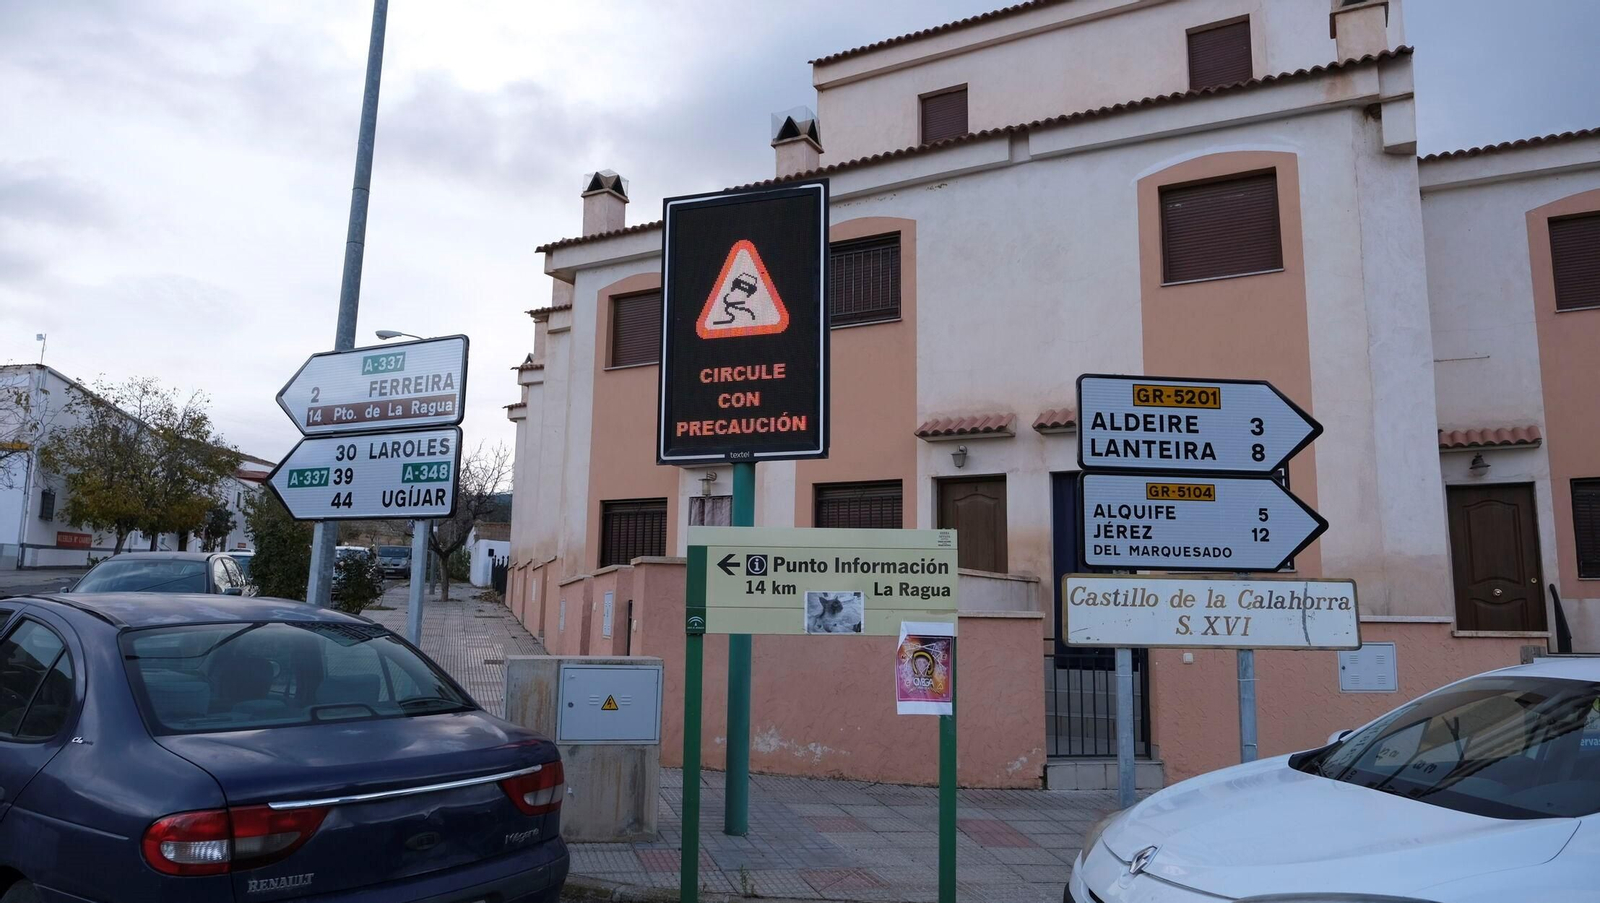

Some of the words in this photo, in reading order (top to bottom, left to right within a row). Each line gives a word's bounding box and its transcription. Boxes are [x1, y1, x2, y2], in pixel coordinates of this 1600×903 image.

[364, 355, 404, 373] A-337
[700, 363, 787, 384] CIRCULE
[310, 386, 321, 404] 2
[369, 372, 455, 398] FERREIRA
[1136, 388, 1218, 406] GR-5201
[717, 391, 761, 409] CON
[308, 409, 322, 423] 14
[333, 407, 357, 421] Pto.
[365, 404, 380, 418] de
[388, 402, 403, 416] La
[411, 400, 453, 416] Ragua
[676, 411, 808, 437] PRECAUCIÓN
[1091, 412, 1200, 434] ALDEIRE
[1250, 417, 1264, 436] 3
[335, 443, 357, 462] 30
[369, 438, 451, 460] LAROLES
[730, 451, 750, 459] textel
[1091, 438, 1217, 461] LANTEIRA
[1251, 443, 1266, 462] 8
[289, 469, 328, 486] A-337
[333, 468, 354, 485] 39
[403, 464, 448, 481] A-348
[331, 491, 353, 509] 44
[382, 485, 446, 508] UGÍJAR
[1149, 485, 1213, 499] GR-5104
[1093, 504, 1176, 520] ALQUIFE
[1258, 508, 1269, 522] 5
[1093, 522, 1153, 540] JÉREZ
[1251, 528, 1270, 542] 12
[1093, 545, 1121, 556] DEL
[1129, 546, 1233, 558] MARQUESADO
[773, 556, 828, 574] Punto
[834, 557, 949, 575] Información
[745, 580, 766, 595] 14
[772, 580, 797, 595] km
[874, 582, 893, 597] La
[899, 582, 951, 600] Ragua
[1070, 585, 1159, 608] Castillo
[1169, 588, 1196, 608] de
[1205, 587, 1227, 609] la
[1238, 588, 1352, 611] Calahorra
[1176, 615, 1193, 636] S.
[1201, 616, 1252, 637] XVI
[247, 873, 315, 893] RENAULT
